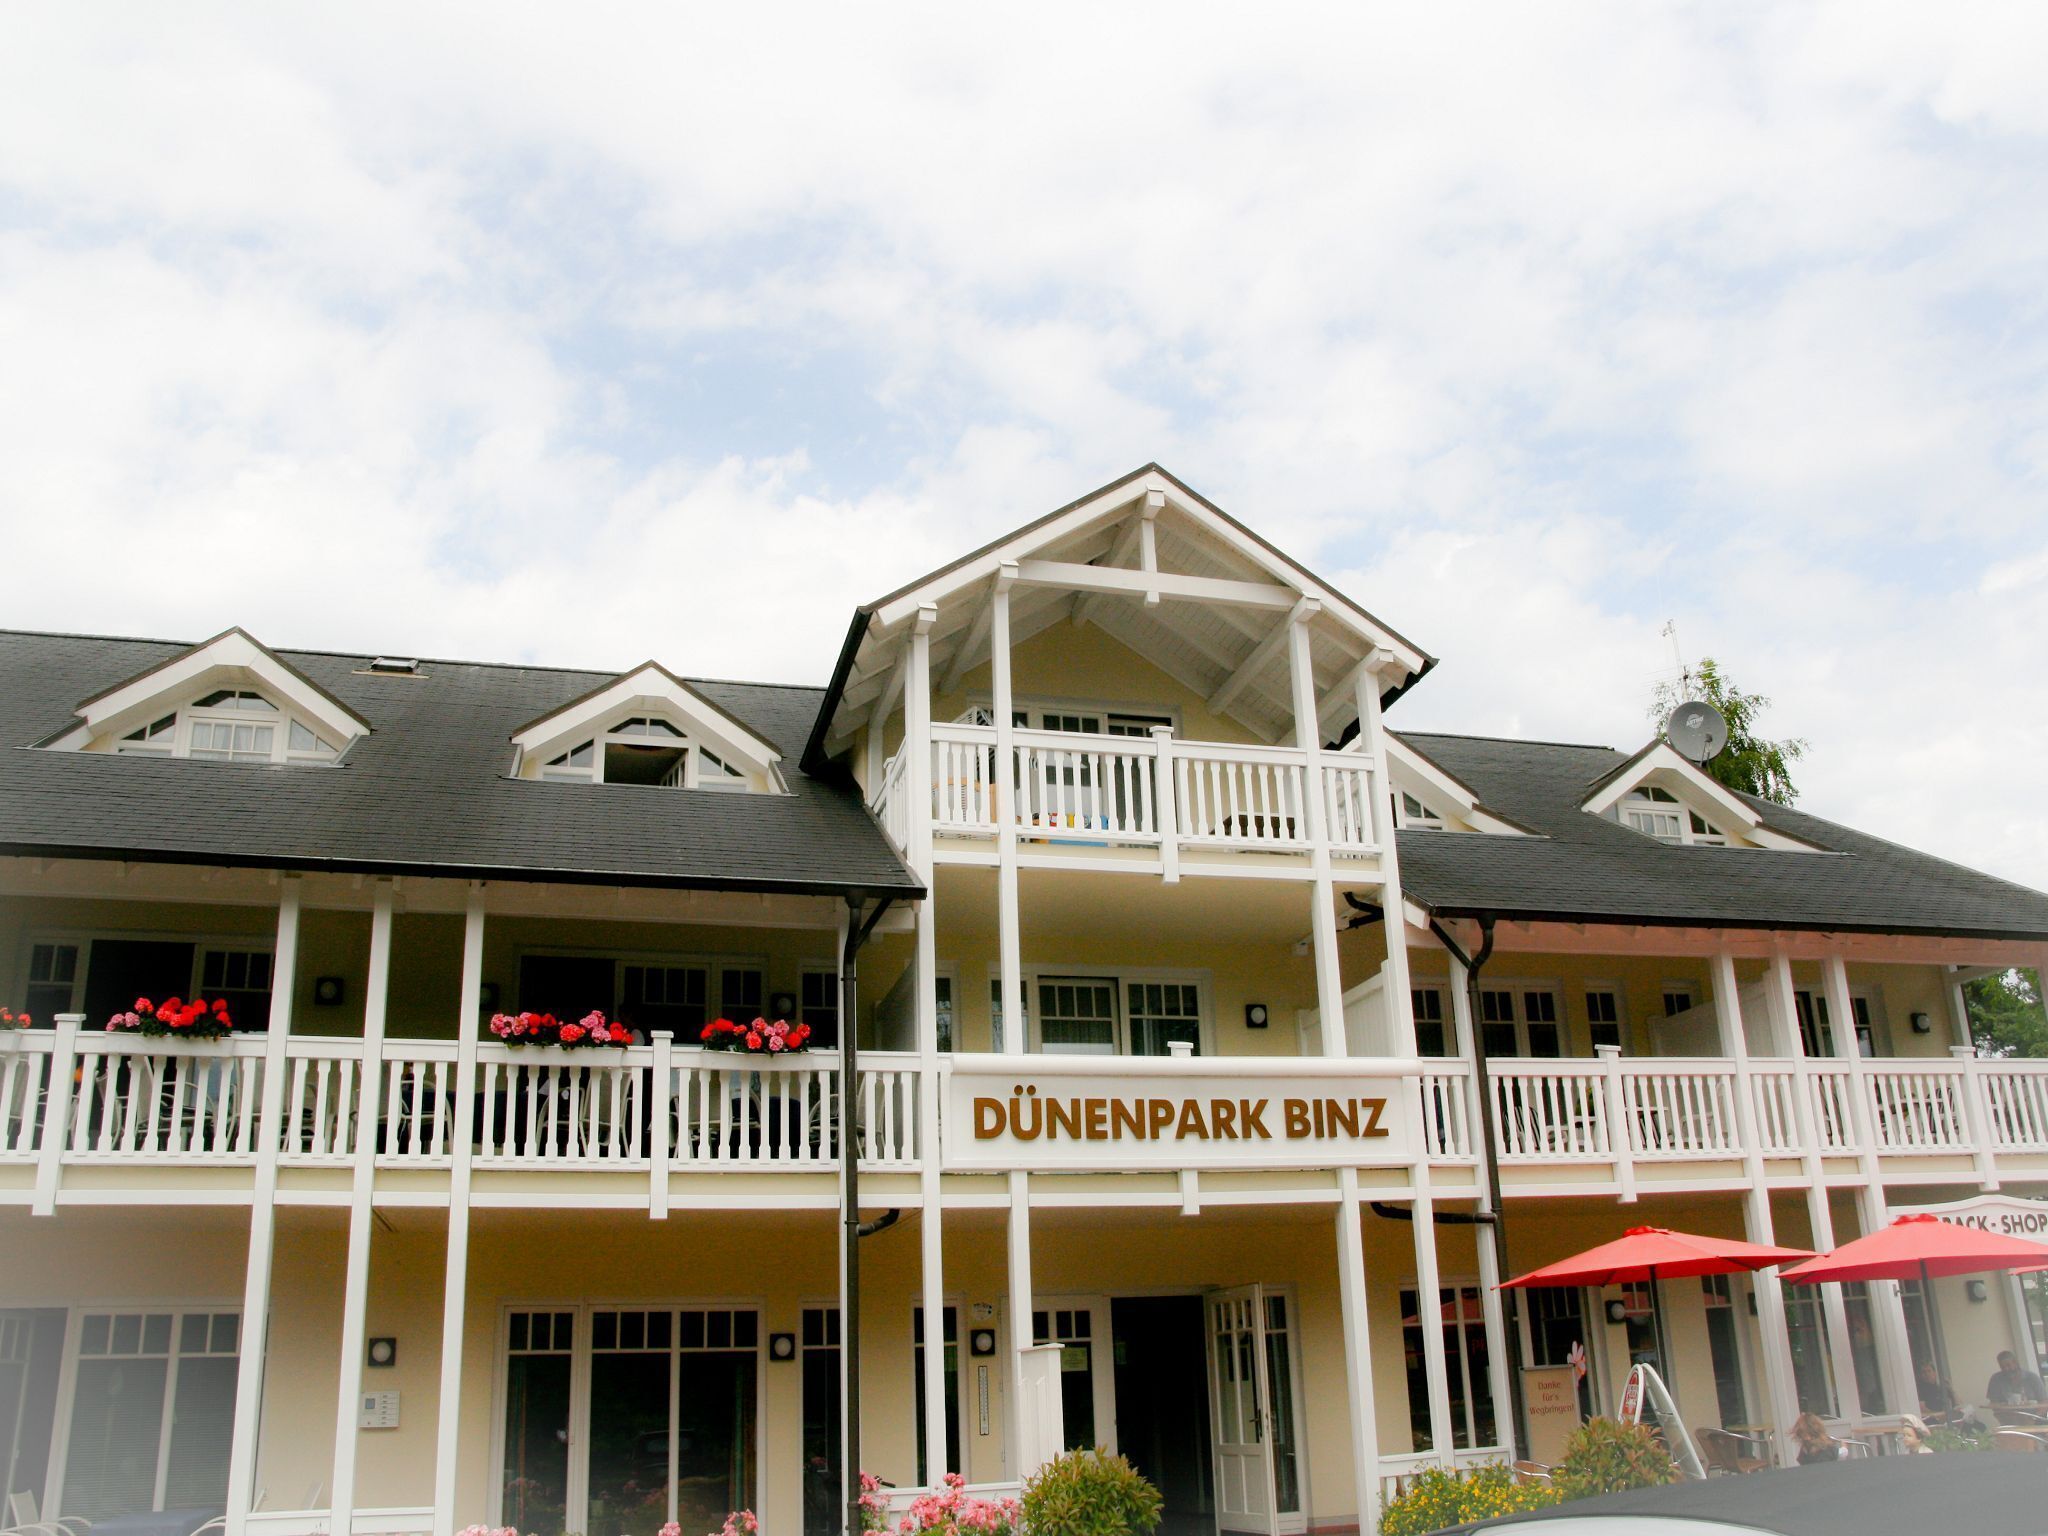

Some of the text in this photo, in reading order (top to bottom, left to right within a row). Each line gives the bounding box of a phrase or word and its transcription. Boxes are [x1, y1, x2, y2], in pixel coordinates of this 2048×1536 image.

[973, 1084, 1390, 1141] DÜNENPARK BINZ
[1537, 1381, 1561, 1391] Danke
[1529, 1402, 1574, 1416] Wegbringen!
